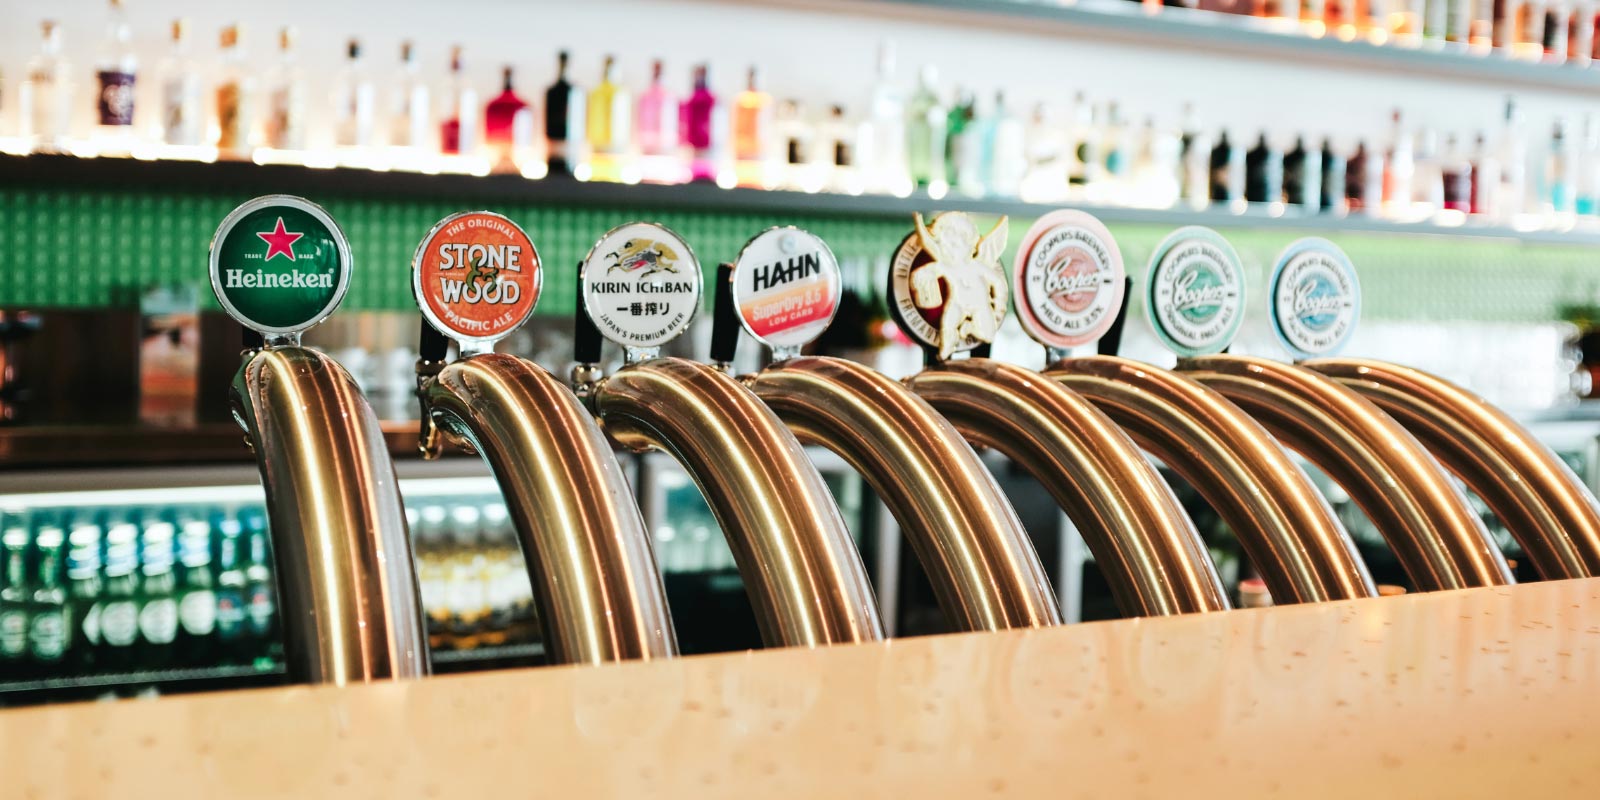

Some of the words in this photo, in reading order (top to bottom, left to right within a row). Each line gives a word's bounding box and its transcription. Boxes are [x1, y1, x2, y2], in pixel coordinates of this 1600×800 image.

[446, 221, 465, 237] THE
[467, 218, 516, 239] ORIGINAL
[439, 243, 522, 272] STONE
[1035, 230, 1073, 269] COOPERS
[226, 268, 334, 288] Heineken
[466, 256, 499, 294] &
[753, 250, 820, 292] HAHN
[440, 277, 521, 304] WOOD
[591, 281, 631, 293] KIRIN
[636, 281, 693, 293] ICHIBAN
[444, 310, 491, 331] PACIFIC
[493, 311, 514, 329] ALE
[616, 302, 670, 316] 一番搾り
[768, 315, 788, 327] LOW
[790, 307, 814, 320] CARB
[900, 298, 940, 343] FREMANT
[1040, 303, 1062, 326] MILD
[1064, 319, 1082, 330] ALE
[600, 313, 628, 338] JAPAN'S
[629, 327, 668, 341] PREMIUM
[667, 312, 685, 332] BEER
